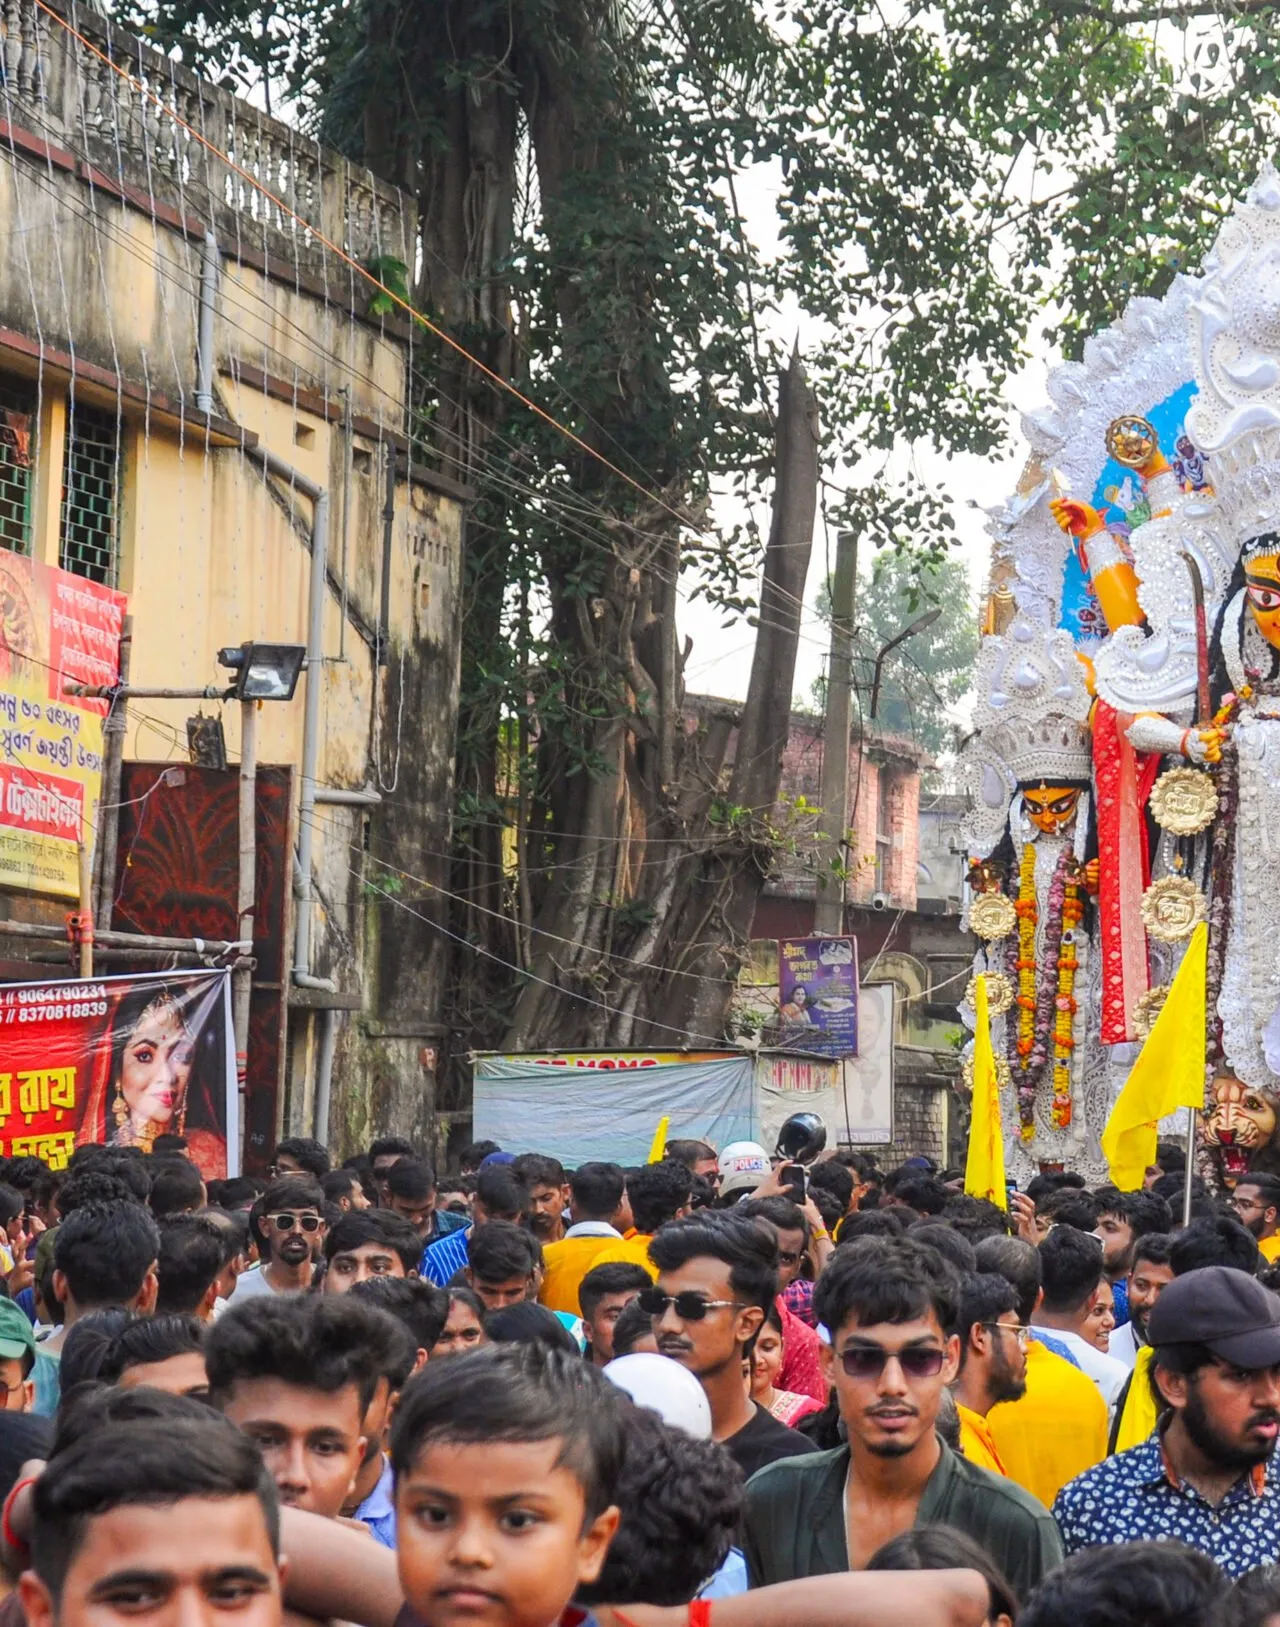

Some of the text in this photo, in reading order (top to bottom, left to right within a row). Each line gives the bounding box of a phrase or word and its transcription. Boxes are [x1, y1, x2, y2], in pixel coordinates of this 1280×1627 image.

[36, 735, 73, 767] জয়ন্তী
[18, 984, 107, 1004] 9064790231
[18, 1001, 108, 1022] 8370818839
[17, 1066, 78, 1125] রায়
[734, 1157, 764, 1172] POLICE
